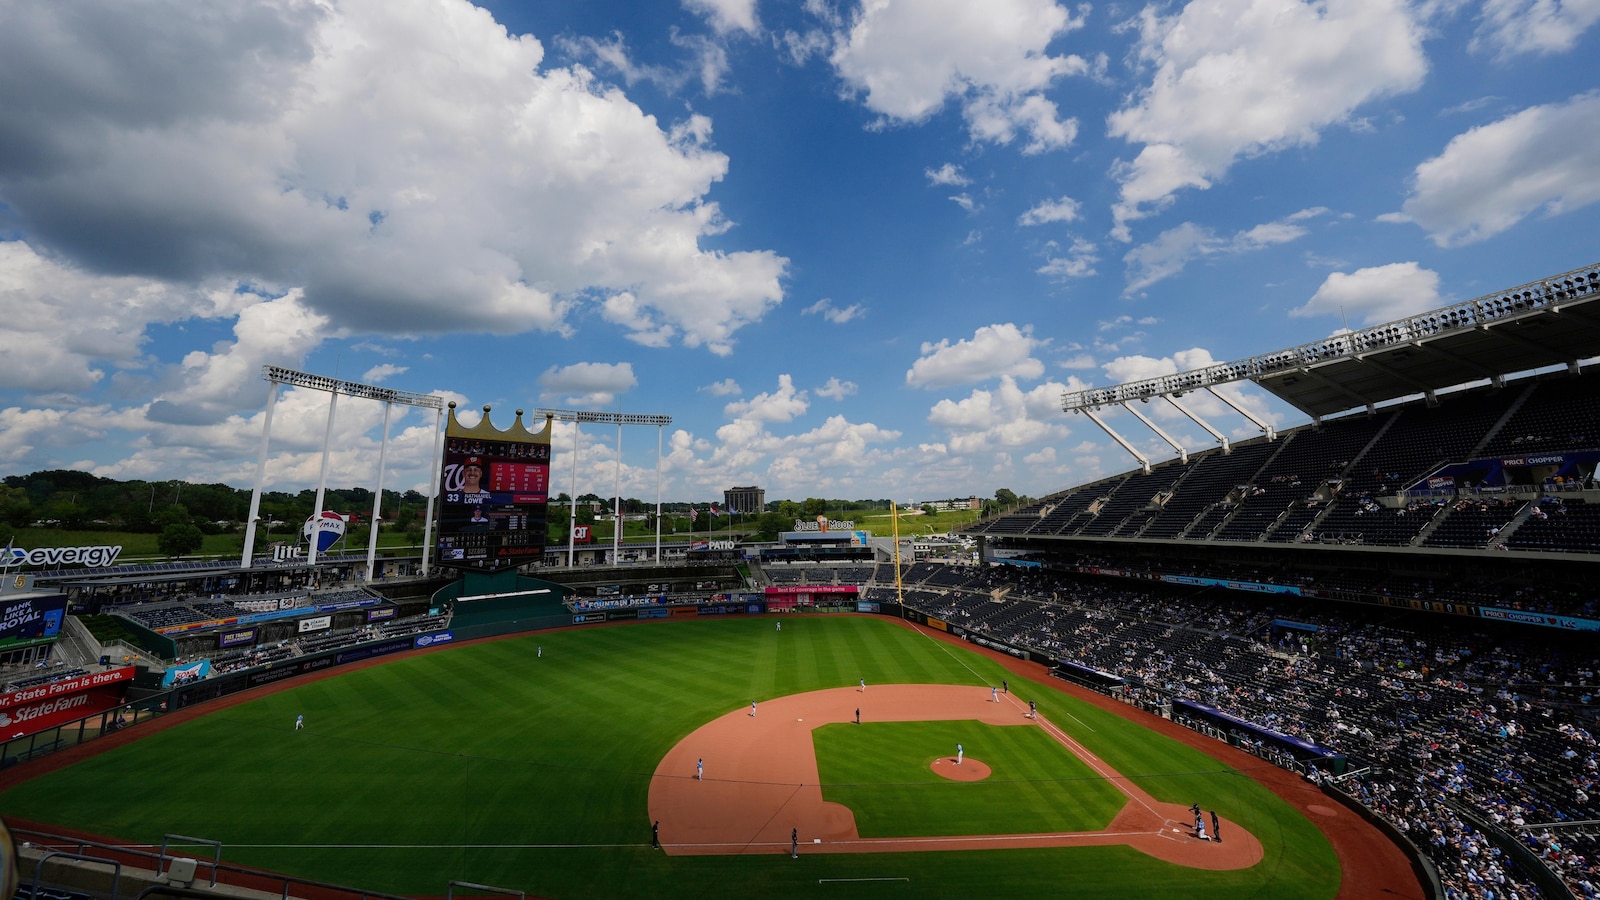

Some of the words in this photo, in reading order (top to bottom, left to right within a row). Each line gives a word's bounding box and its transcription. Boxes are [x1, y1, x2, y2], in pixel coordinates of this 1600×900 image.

[1527, 456, 1563, 465] CHOPPER
[1430, 480, 1454, 489] CHOPPER
[447, 493, 459, 502] 33
[793, 518, 819, 532] BLUE
[828, 521, 855, 530] MOON
[574, 526, 588, 539] QT
[708, 541, 735, 550] PATIO
[30, 547, 120, 567] evergy
[272, 545, 302, 562] Lite
[13, 576, 25, 588] 5
[6, 600, 32, 614] BANK
[588, 599, 629, 608] FOUNTAIN
[0, 610, 41, 631] ROYAL
[4, 609, 25, 621] LIKE
[1508, 613, 1543, 623] CHOPPER
[1561, 619, 1577, 628] KC
[177, 669, 200, 679] SONIC
[14, 690, 47, 703] State
[49, 681, 79, 696] Farm
[81, 676, 91, 687] is
[92, 670, 122, 684] there.
